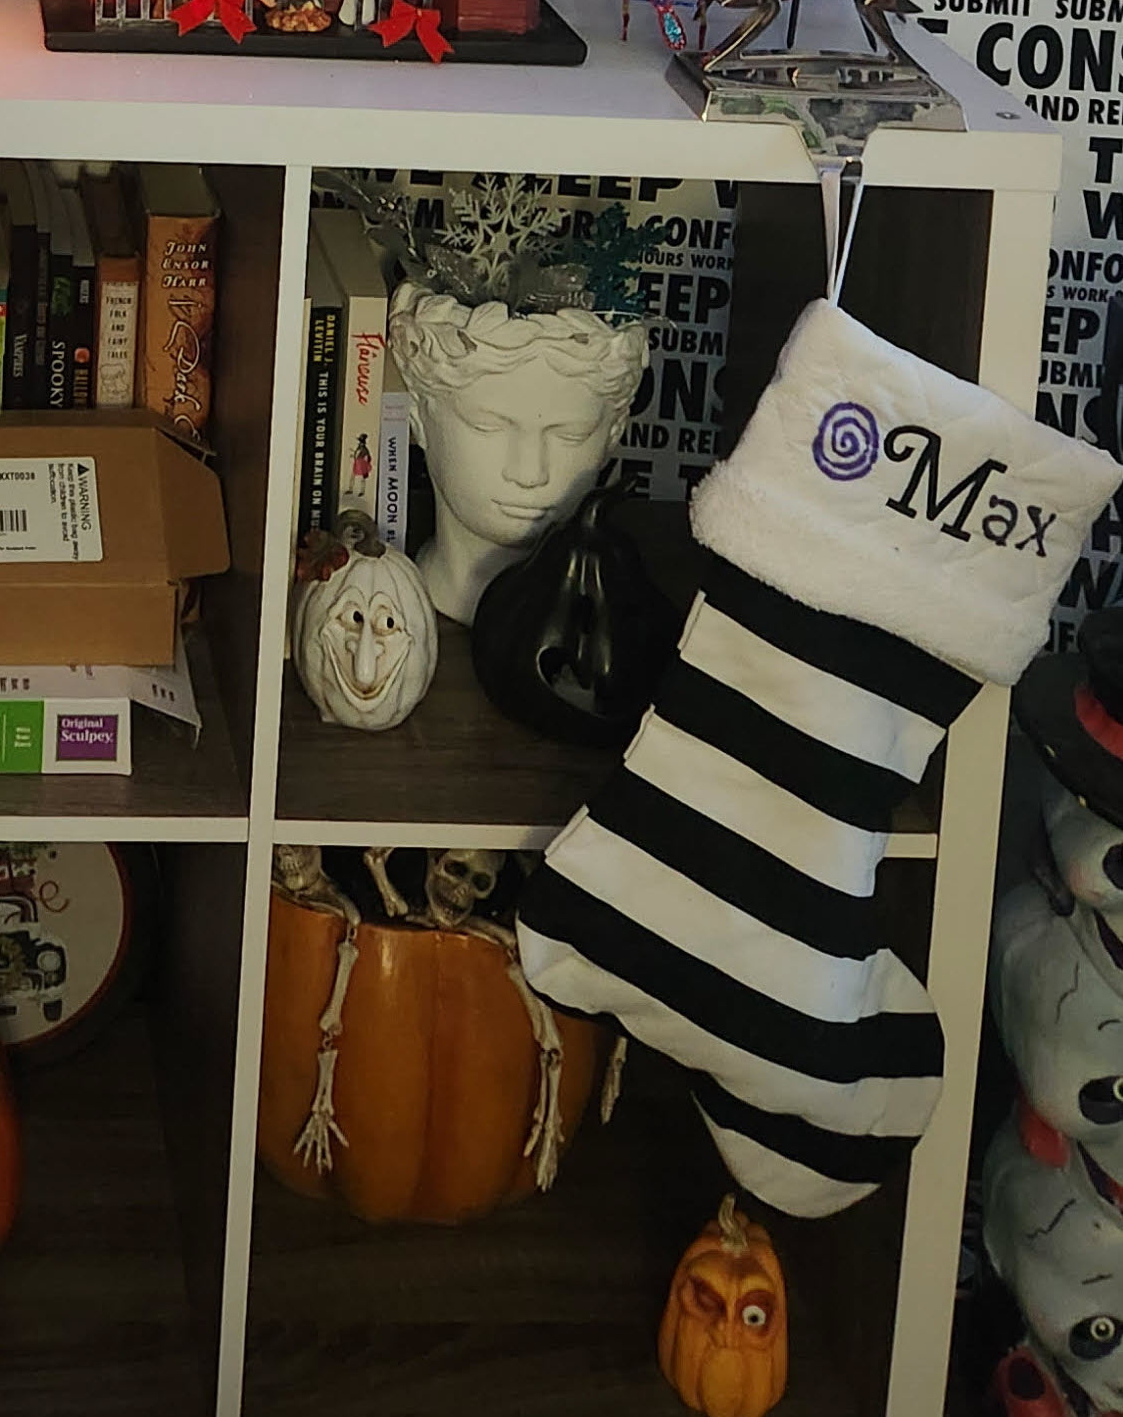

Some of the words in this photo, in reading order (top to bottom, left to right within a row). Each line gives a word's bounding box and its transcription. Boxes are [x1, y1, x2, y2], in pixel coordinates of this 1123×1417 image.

[165, 241, 207, 256] JOHN
[162, 259, 210, 271] ENSOR
[111, 324, 125, 332] AND
[313, 319, 325, 363] LEVITIN
[325, 314, 336, 353] DANIEL
[49, 341, 66, 409] SPOOKY
[317, 370, 328, 397] THIS
[316, 401, 327, 414] IS
[314, 418, 327, 447] YOUR
[312, 451, 325, 486] BRAIN
[387, 437, 398, 472] WHEN
[78, 476, 92, 531] WARNING
[311, 489, 323, 505] ON
[386, 477, 399, 524] MOON
[883, 424, 1057, 558] Max
[61, 718, 104, 730] Original
